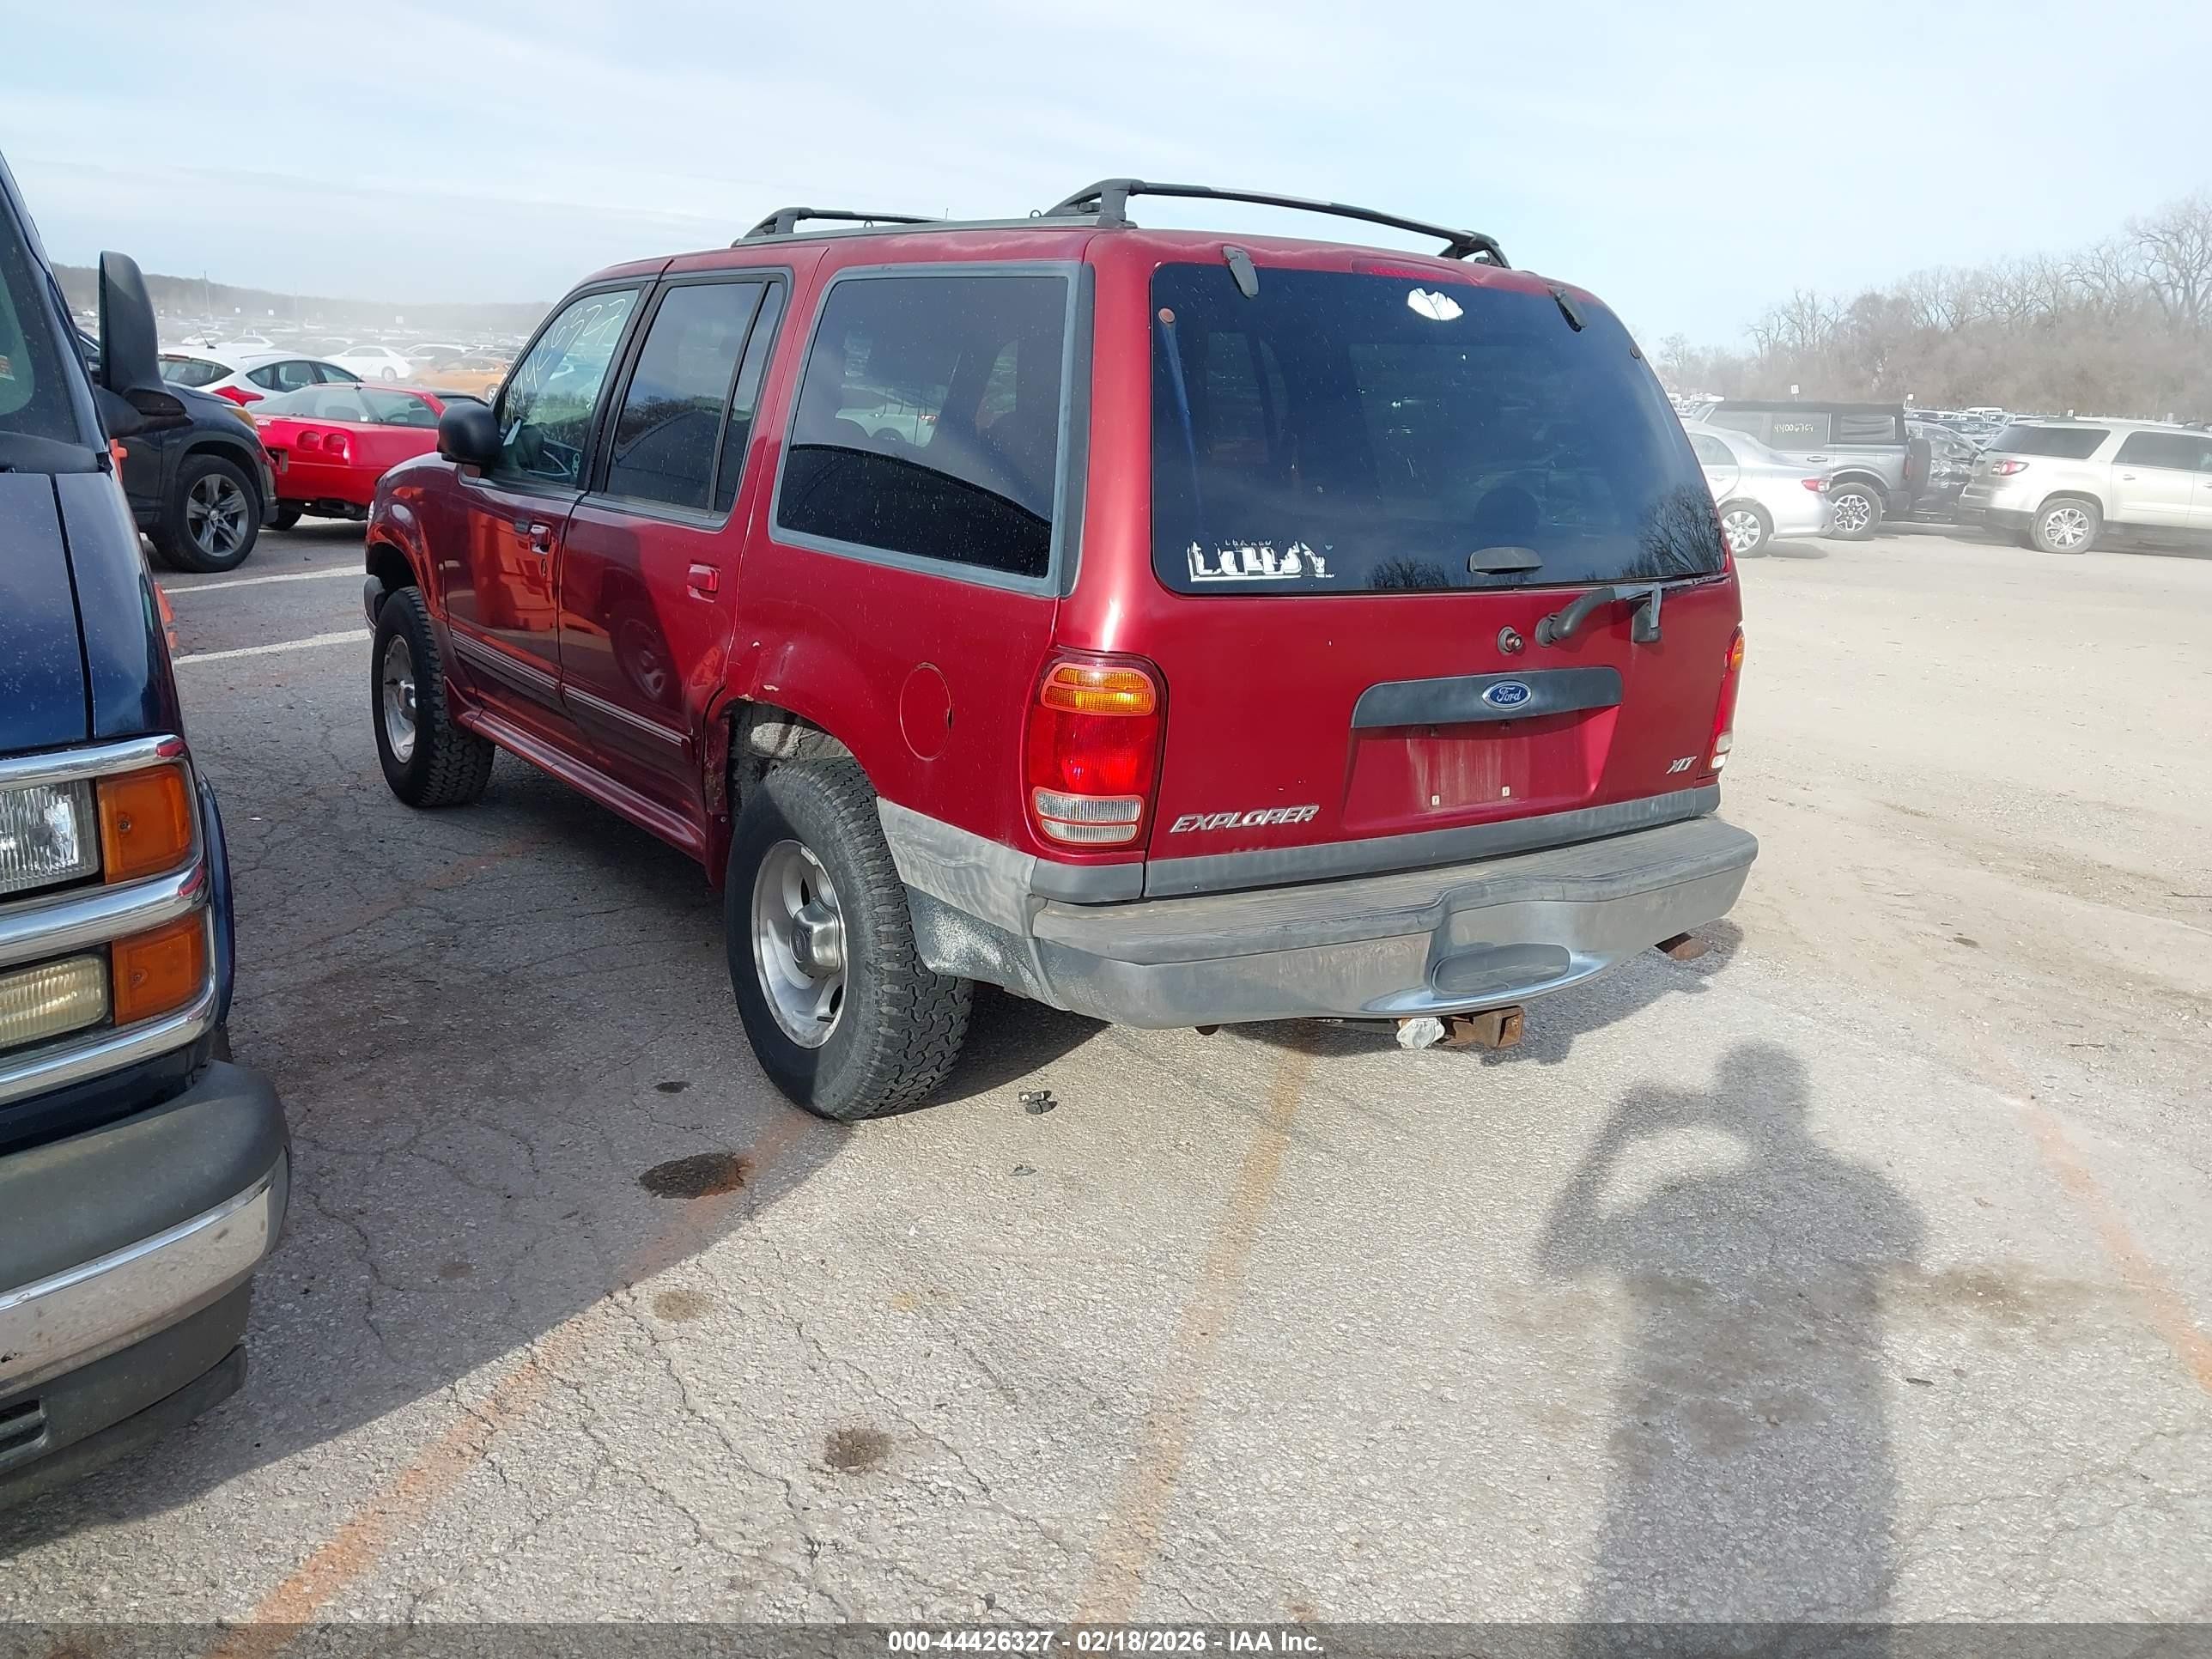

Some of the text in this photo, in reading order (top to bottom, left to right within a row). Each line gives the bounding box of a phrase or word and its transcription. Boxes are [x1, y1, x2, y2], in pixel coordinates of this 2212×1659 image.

[1496, 686, 1522, 702] Ford
[1665, 755, 1698, 775] XLT
[1170, 805, 1320, 833] EXPLORER
